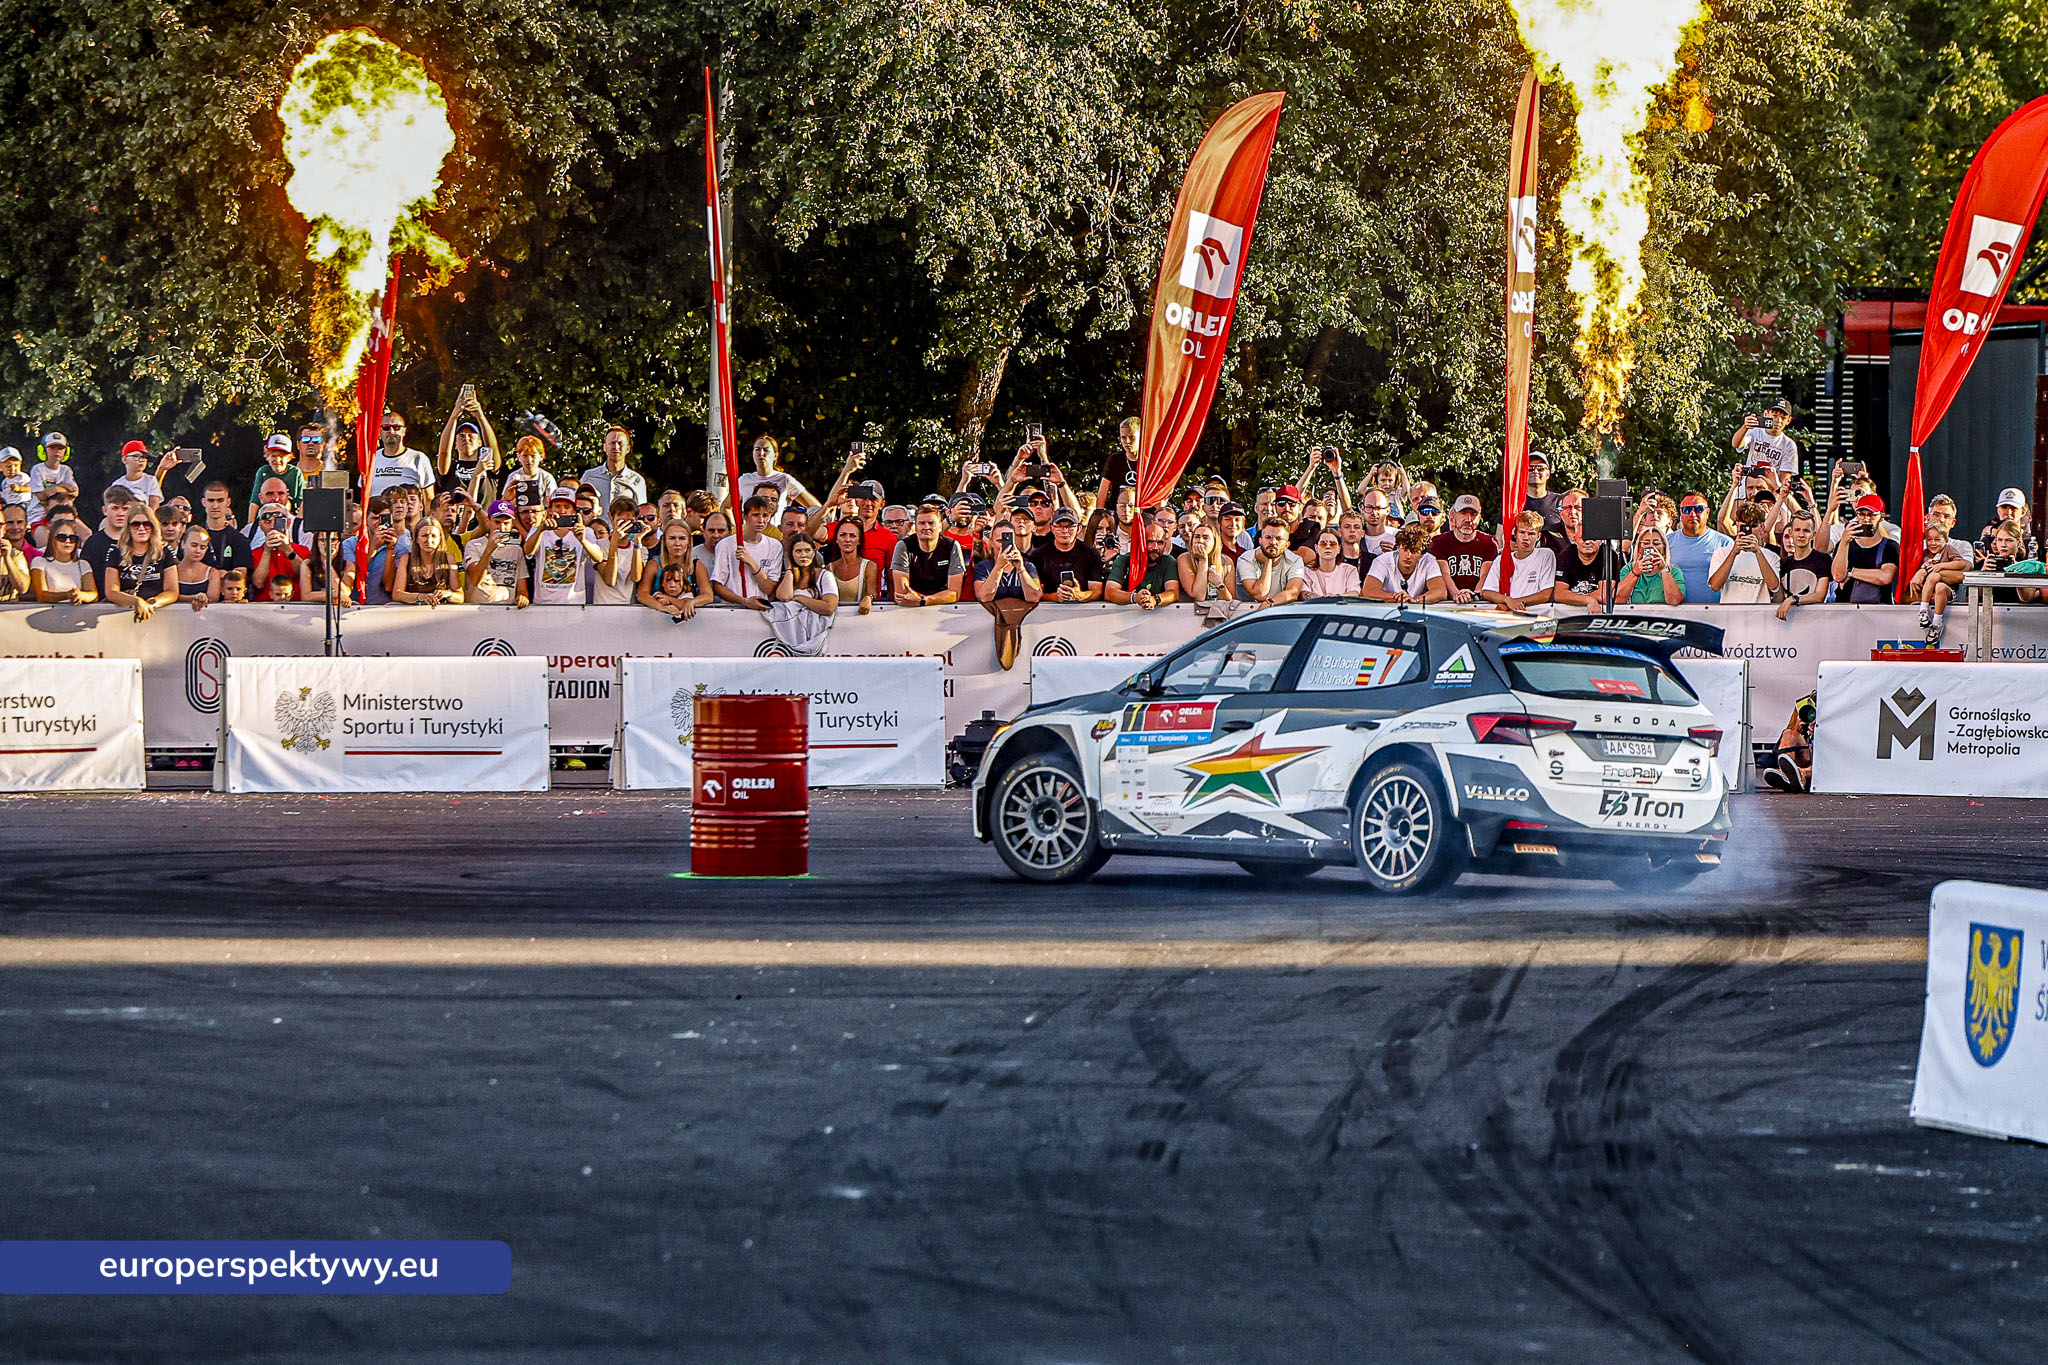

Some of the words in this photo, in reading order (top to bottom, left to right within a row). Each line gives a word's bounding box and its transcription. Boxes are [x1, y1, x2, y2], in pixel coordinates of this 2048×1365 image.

[1587, 618, 1687, 636] BULACIA
[1310, 655, 1360, 671] M.Bulacia
[1378, 648, 1403, 684] 7
[1308, 671, 1355, 686] J.Murado
[0, 693, 55, 709] rstwo
[343, 693, 463, 711] Ministerstwo
[815, 710, 898, 730] Turystyki
[1127, 704, 1143, 731] 7
[1178, 707, 1203, 715] ORLEN
[1594, 714, 1677, 727] SKODA
[1949, 706, 2031, 724] Górnośląsko
[2, 717, 6, 733] i
[11, 714, 97, 736] Turystyki
[342, 717, 404, 738] Sportu
[410, 717, 415, 735] i
[420, 717, 504, 738] Turystyki
[1947, 741, 2021, 758] Metropolia
[732, 778, 775, 789] ORLEN
[732, 790, 750, 799] OIL
[1617, 821, 1669, 830] ENERGY
